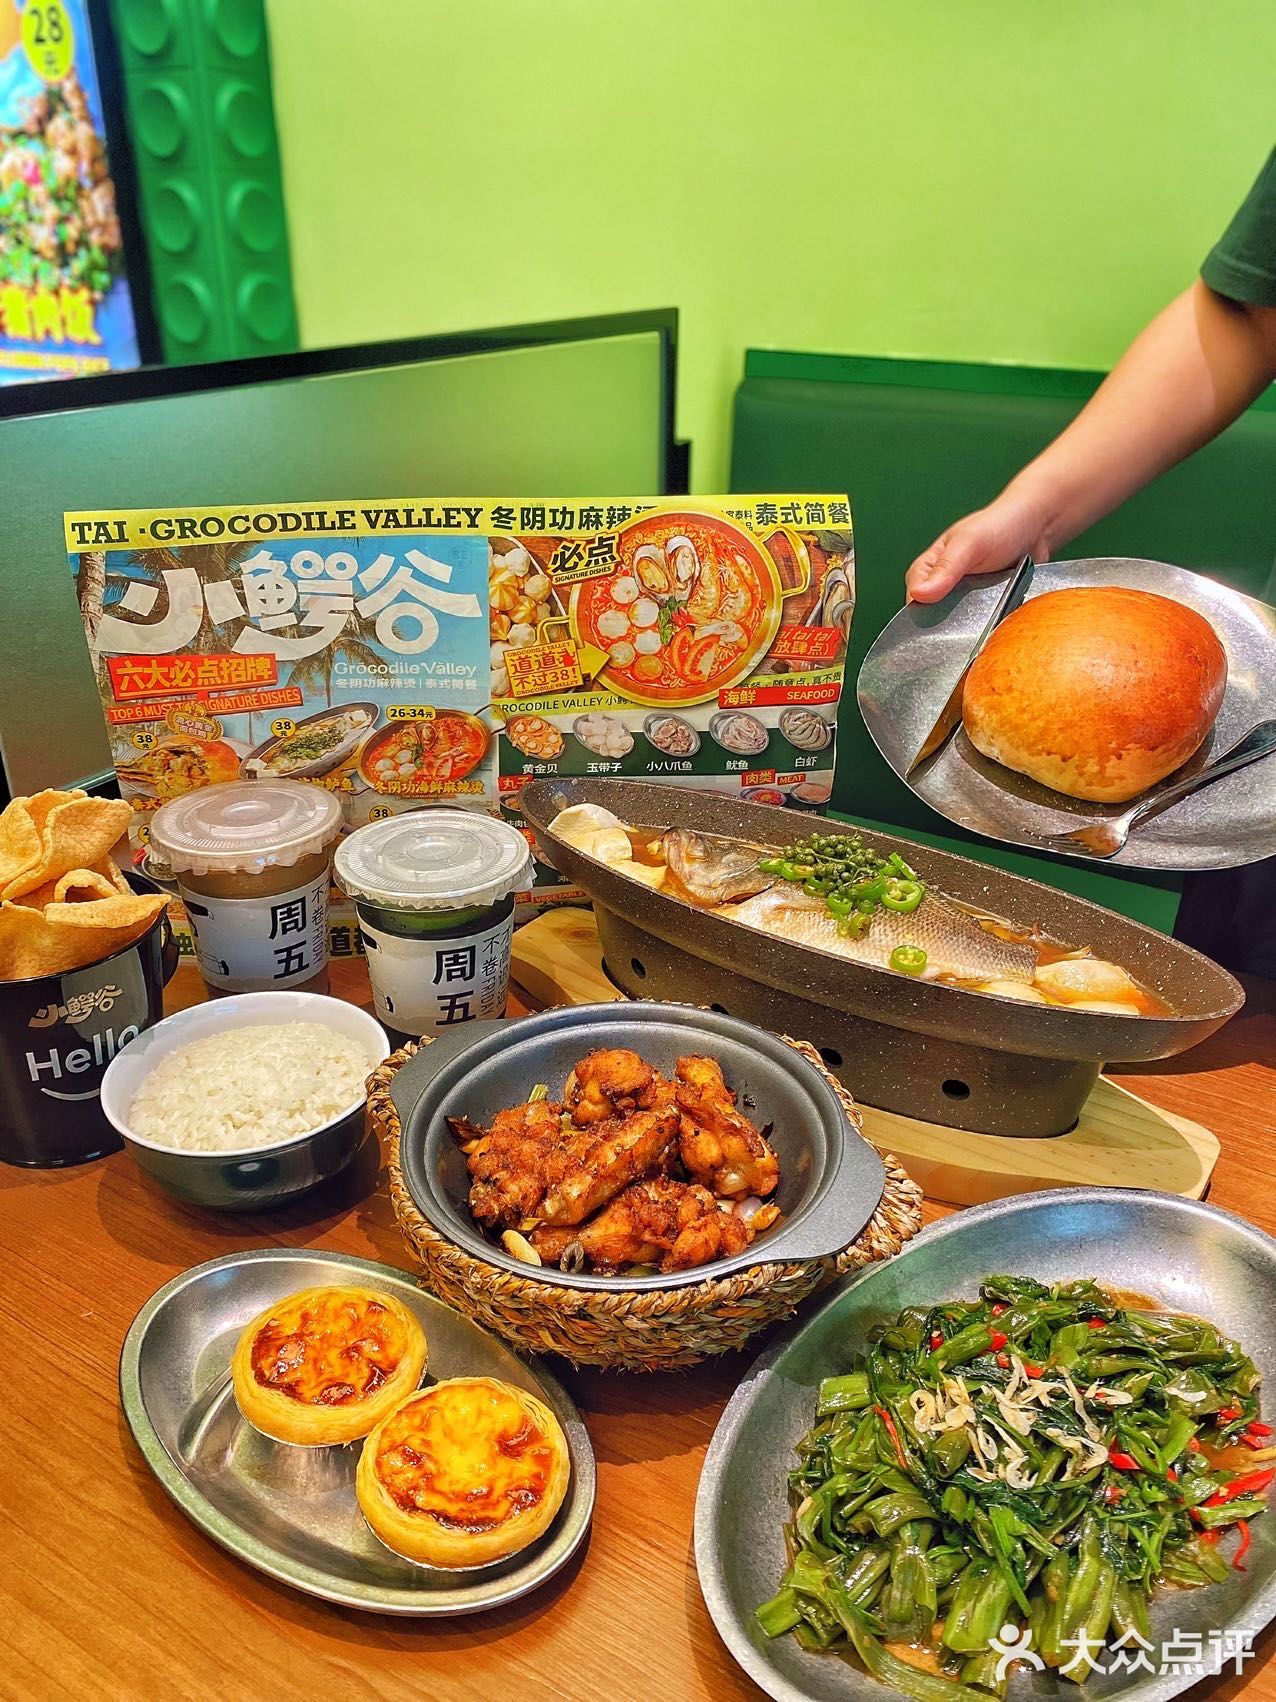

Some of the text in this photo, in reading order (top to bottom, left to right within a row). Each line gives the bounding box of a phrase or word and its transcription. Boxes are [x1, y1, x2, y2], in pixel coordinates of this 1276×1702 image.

[30, 6, 63, 44] 28
[490, 505, 658, 531] 冬阴功麻辣
[756, 502, 850, 526] 泰式简餐
[71, 520, 130, 545] TAI
[361, 507, 484, 530] VALLEY
[551, 535, 618, 574] 必点
[554, 565, 612, 583] SIGNATURE DISHES
[94, 549, 483, 661] 小鳄谷
[116, 657, 273, 692] 六大必点招牌
[723, 689, 757, 706] 海鲜
[786, 688, 835, 700] SEAFOOD
[111, 708, 134, 720] TOP
[135, 707, 144, 717] 6
[257, 688, 301, 706] DISHES
[500, 696, 603, 713] ROCODILE VALLEY
[390, 708, 433, 719] 26-34元
[275, 721, 292, 731] 38
[136, 734, 153, 743] 38
[522, 762, 558, 774] 黄金贝
[586, 761, 622, 773] 玉带子
[646, 760, 693, 772] 小八爪鱼
[725, 759, 749, 771] 鱿鱼
[794, 755, 818, 768] 白虾
[502, 776, 529, 790] 丸子
[745, 771, 774, 785] 肉类
[779, 774, 803, 785] MEAT
[374, 779, 485, 795] 冬阴功海鲜麻辣烫
[373, 809, 389, 818] 38
[268, 896, 310, 980] 周五
[432, 944, 477, 1026] 周五
[27, 984, 123, 1029] 小鳄谷
[25, 1024, 140, 1082] Hello
